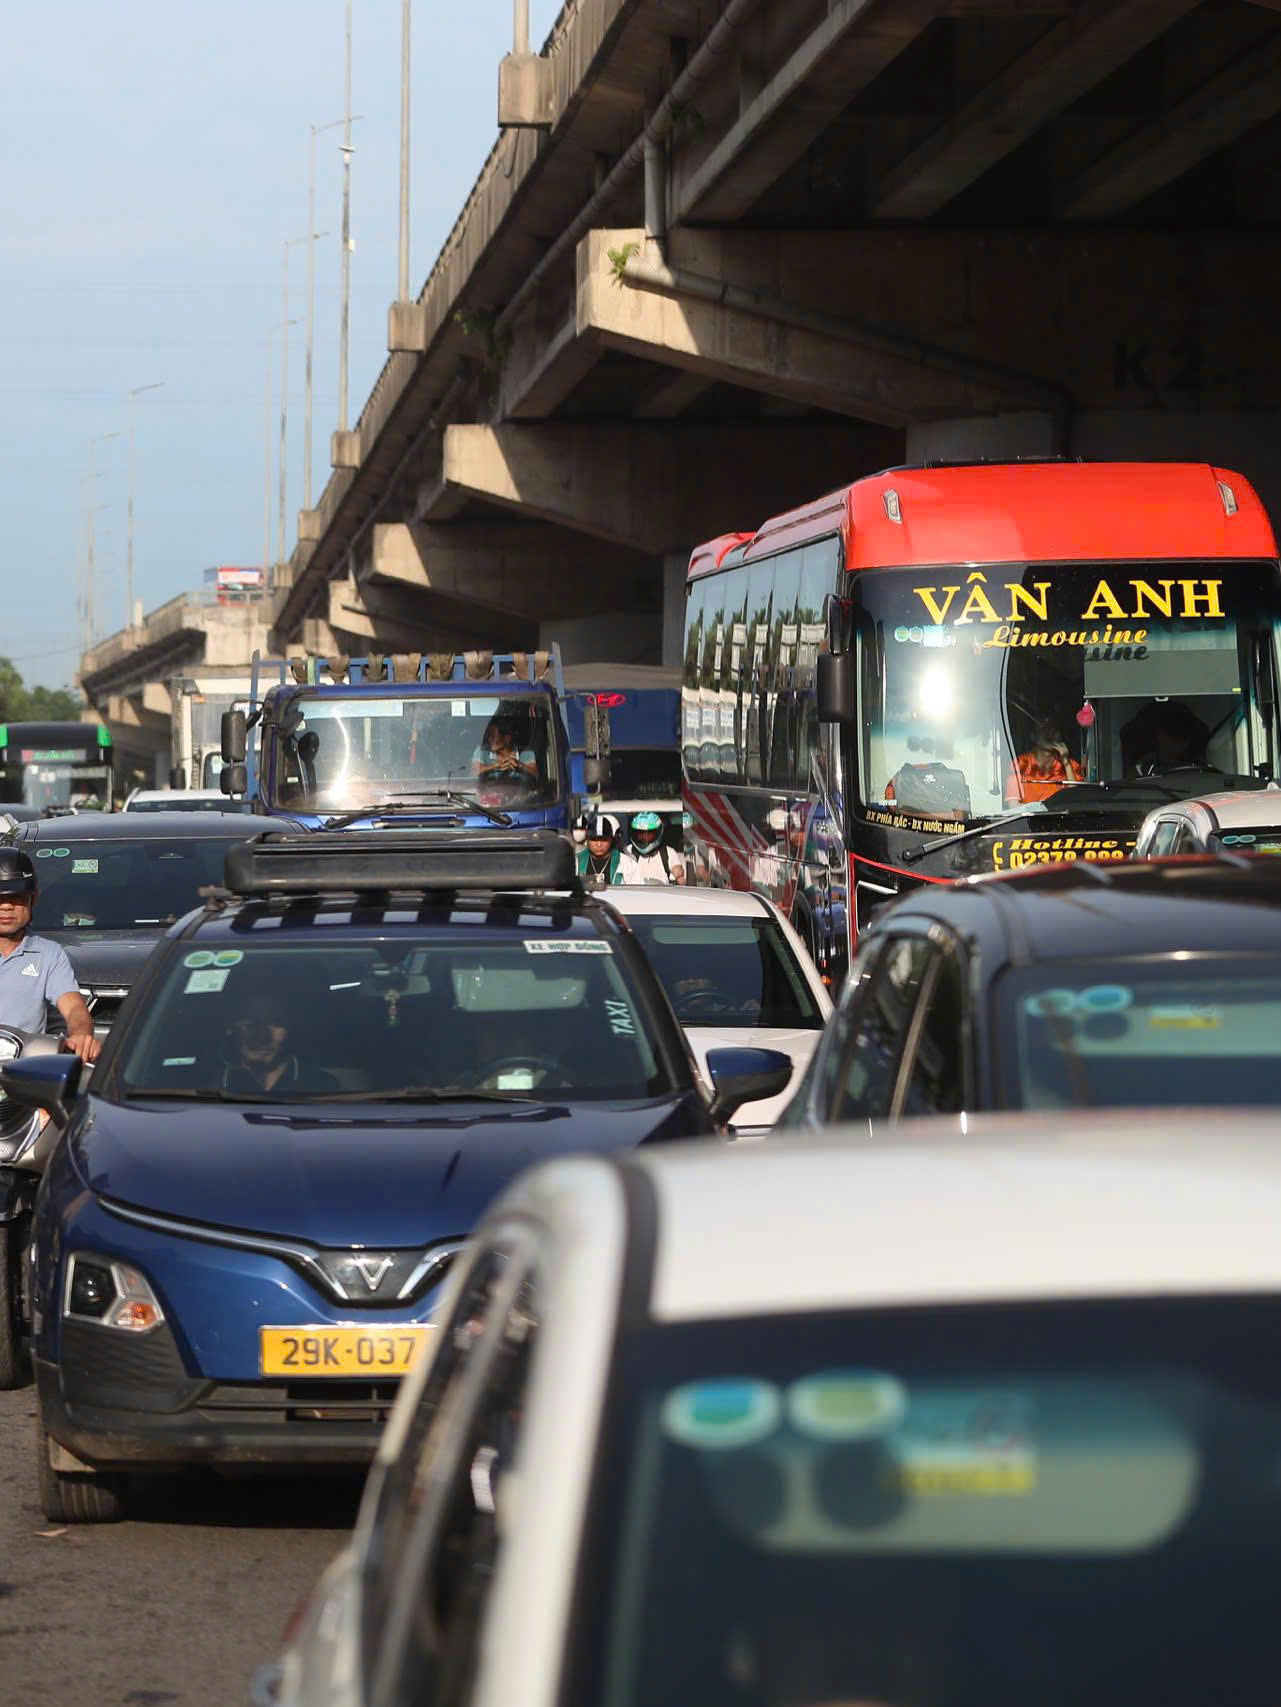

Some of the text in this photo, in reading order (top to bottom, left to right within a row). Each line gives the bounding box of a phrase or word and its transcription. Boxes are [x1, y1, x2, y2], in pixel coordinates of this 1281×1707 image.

[913, 572, 1226, 625] VÂN ANH
[983, 624, 1148, 648] Limousine
[1009, 838, 1119, 850] Hotline
[604, 999, 636, 1035] TAXI
